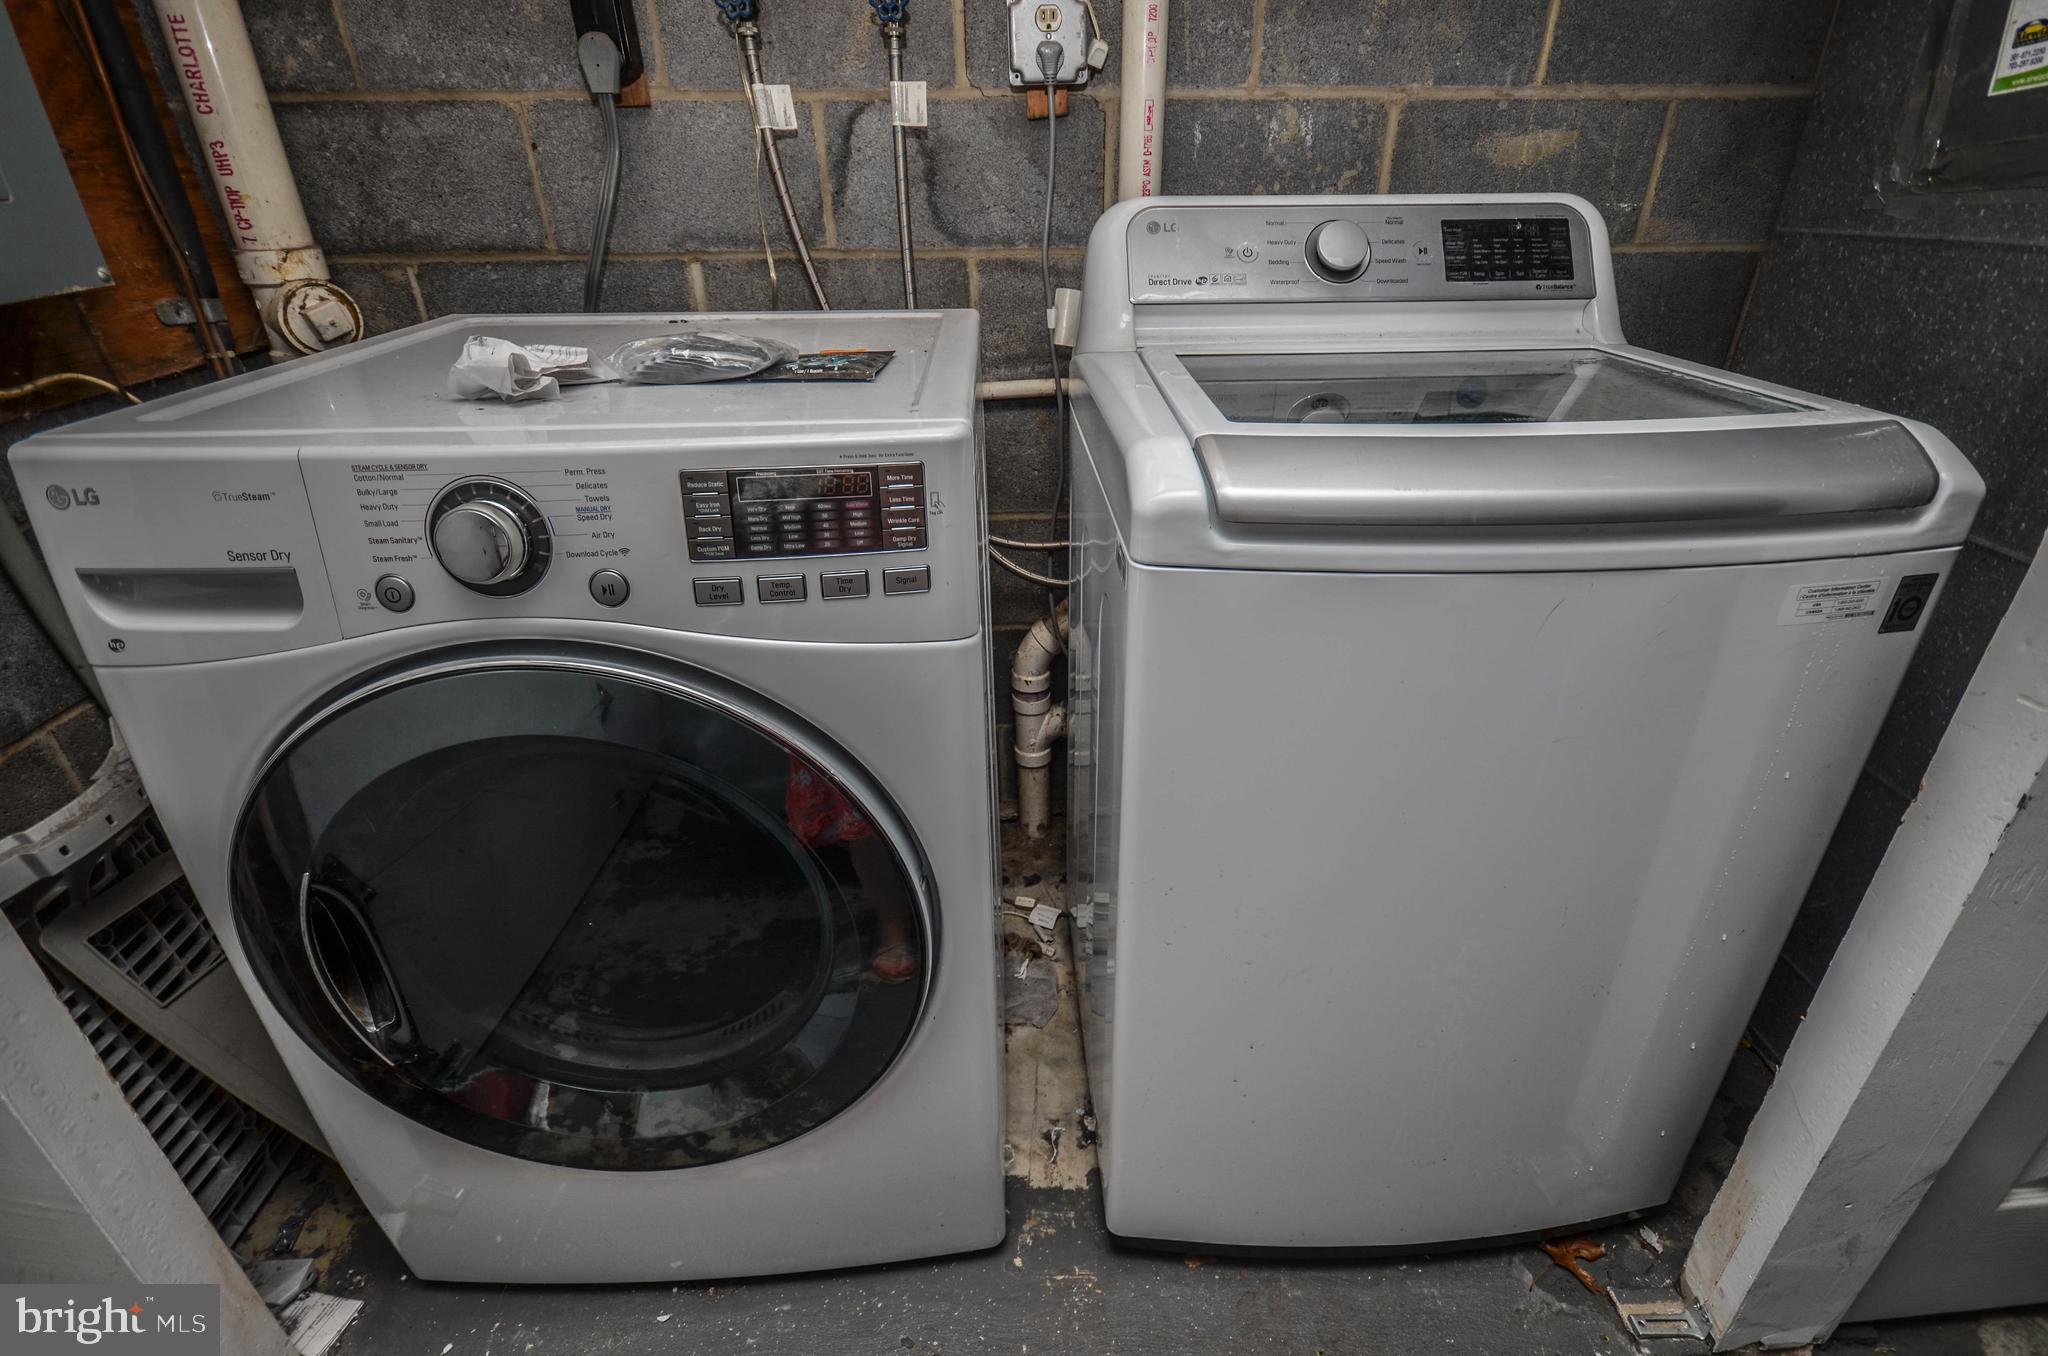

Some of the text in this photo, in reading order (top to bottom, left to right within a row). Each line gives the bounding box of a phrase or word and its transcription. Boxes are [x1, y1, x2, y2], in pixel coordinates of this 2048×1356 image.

[167, 13, 215, 115] CHARLOTTE
[1148, 278, 1192, 286] Direct Drive
[351, 464, 370, 472] STEAM
[371, 464, 388, 472] CYCLE
[394, 464, 416, 472] SENSOR
[564, 468, 584, 476] Perm.
[353, 474, 405, 482] Cotton/Normal
[576, 482, 608, 490] Delicates
[356, 488, 398, 497] Bulky/Large
[71, 488, 100, 506] LG
[584, 494, 610, 502] Towels
[360, 503, 399, 512] Heavy Duty
[576, 513, 612, 522] Speed Dry
[364, 520, 382, 528] Small
[592, 531, 615, 539] Air Dry
[226, 549, 291, 564] Sensor Dry
[566, 549, 618, 559] Download Cycle
[896, 576, 918, 584] Signal
[711, 584, 724, 593] Dry
[770, 582, 792, 590] Temp.
[709, 592, 729, 600] Level
[769, 590, 796, 598] Control
